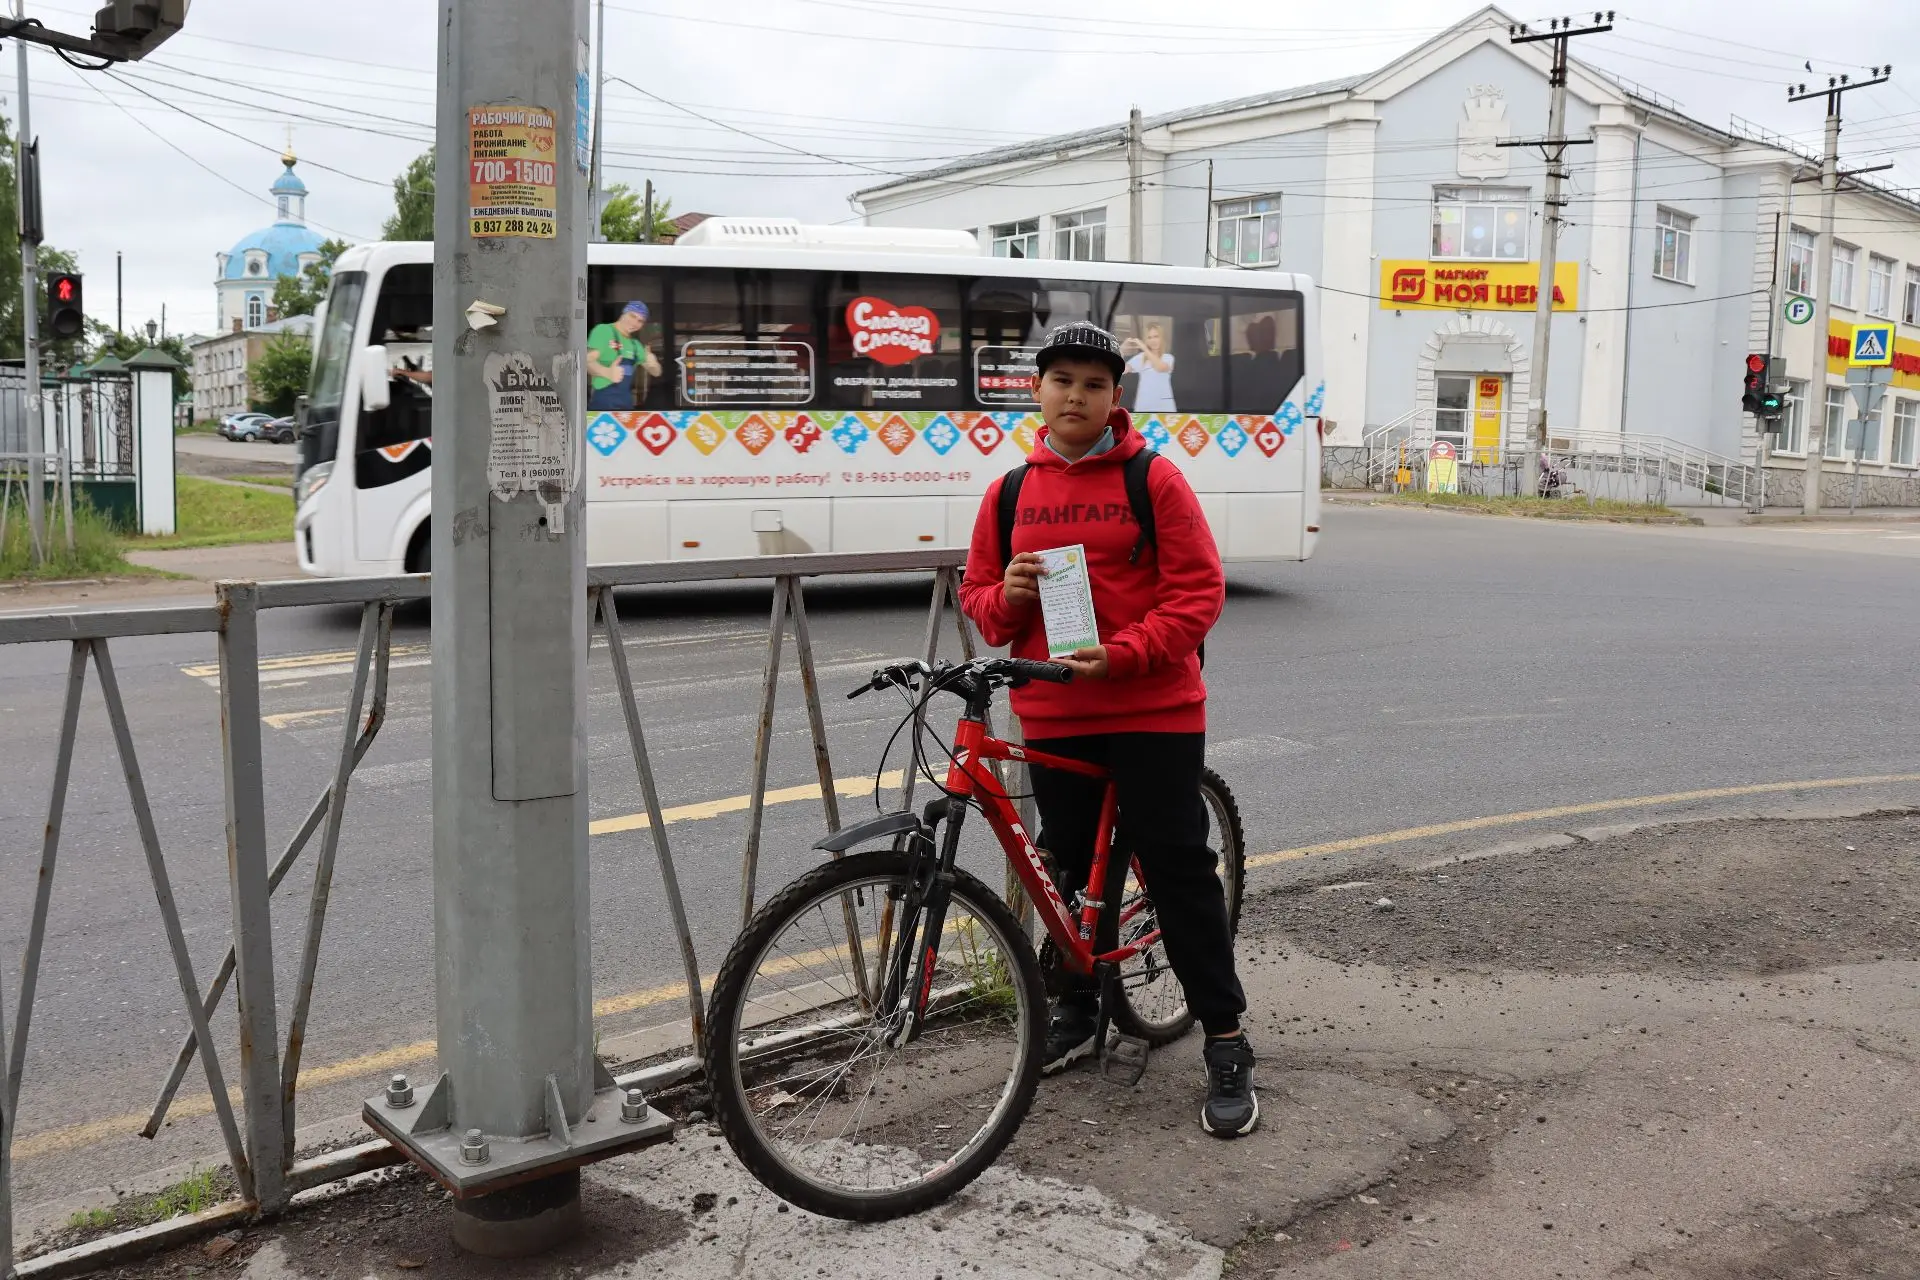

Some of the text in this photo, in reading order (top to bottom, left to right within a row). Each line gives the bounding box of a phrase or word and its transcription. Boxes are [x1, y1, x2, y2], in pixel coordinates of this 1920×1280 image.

[473, 111, 553, 128] РАБОЧИЙ ДОМ
[474, 130, 503, 138] РАБОТА
[473, 139, 527, 148] ПРОЖИВАНИЕ
[473, 149, 508, 158] ПИТАНИЕ
[473, 160, 553, 185] 700-1500
[473, 207, 553, 218] ЕЖЕДНЕВНЫЕ ВЫПЛАТЫ
[474, 220, 553, 234] 8 937 288 24 24
[1434, 269, 1489, 281] МАГНИТ
[1434, 284, 1489, 303] МОЯ
[541, 456, 561, 465] 25%
[500, 470, 519, 478] Тел.
[521, 469, 527, 477] 8
[599, 474, 671, 489] Устройся
[676, 475, 695, 485] на
[700, 475, 771, 488] хорошую
[775, 471, 831, 487] работу!
